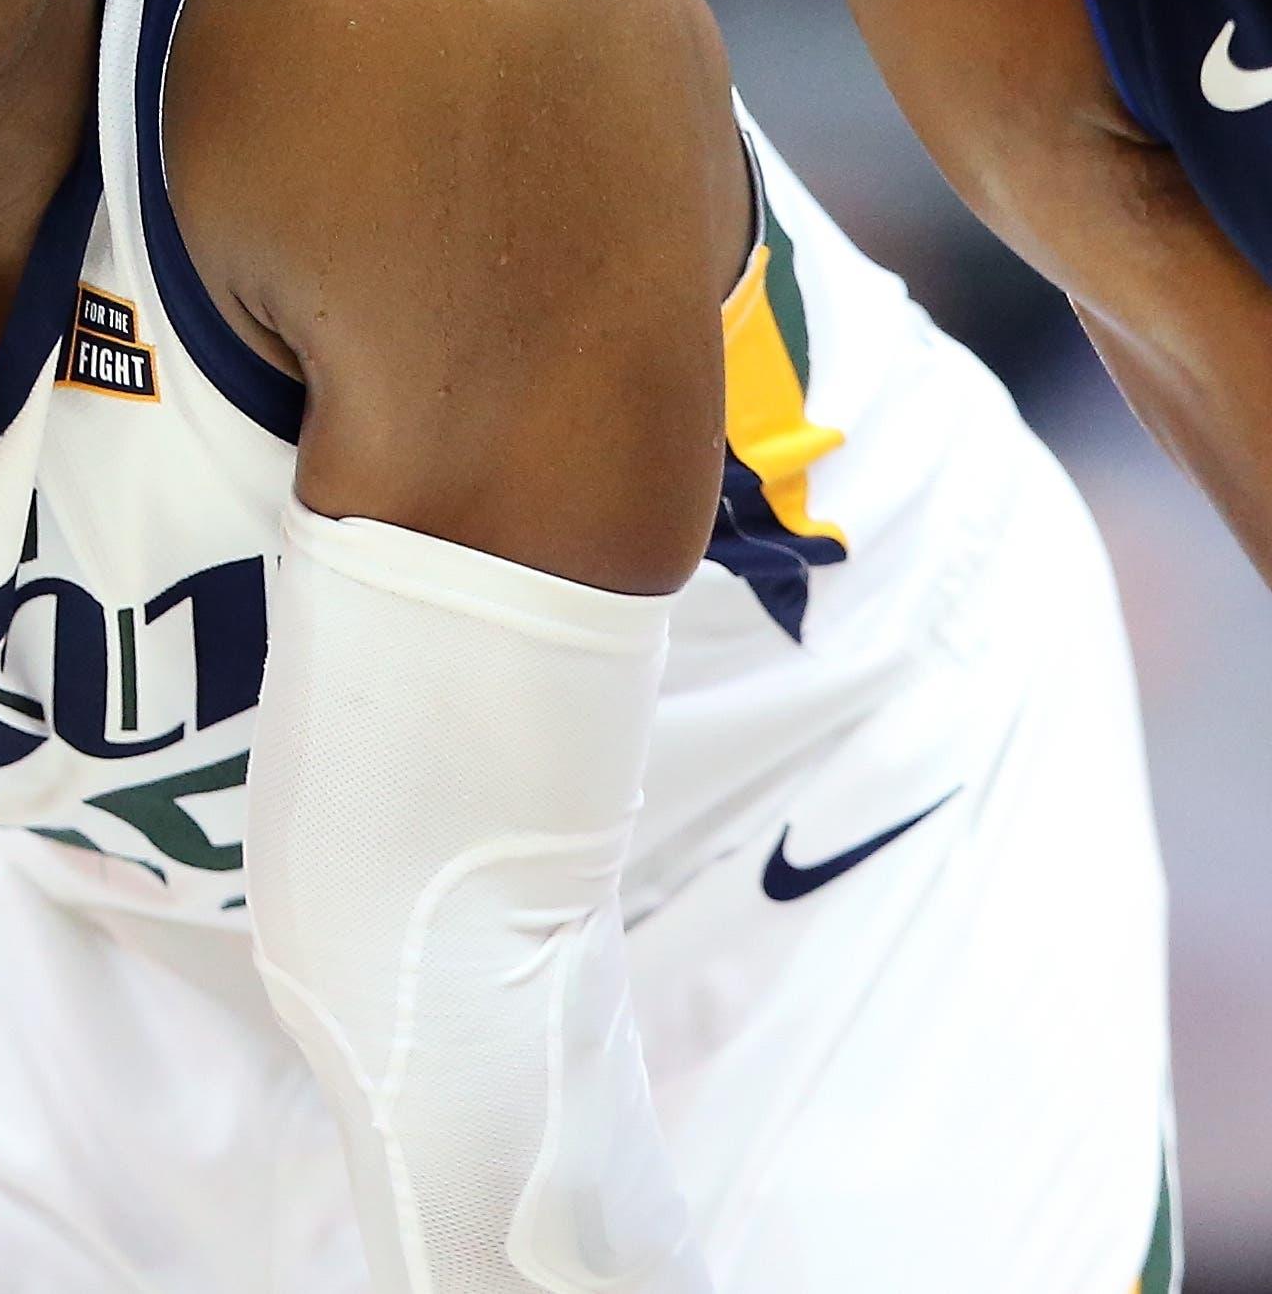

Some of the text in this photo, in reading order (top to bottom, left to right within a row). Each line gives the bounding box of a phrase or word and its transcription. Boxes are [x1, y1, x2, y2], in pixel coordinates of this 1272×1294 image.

[84, 299, 129, 334] FOR THE
[78, 340, 145, 388] FIGHT
